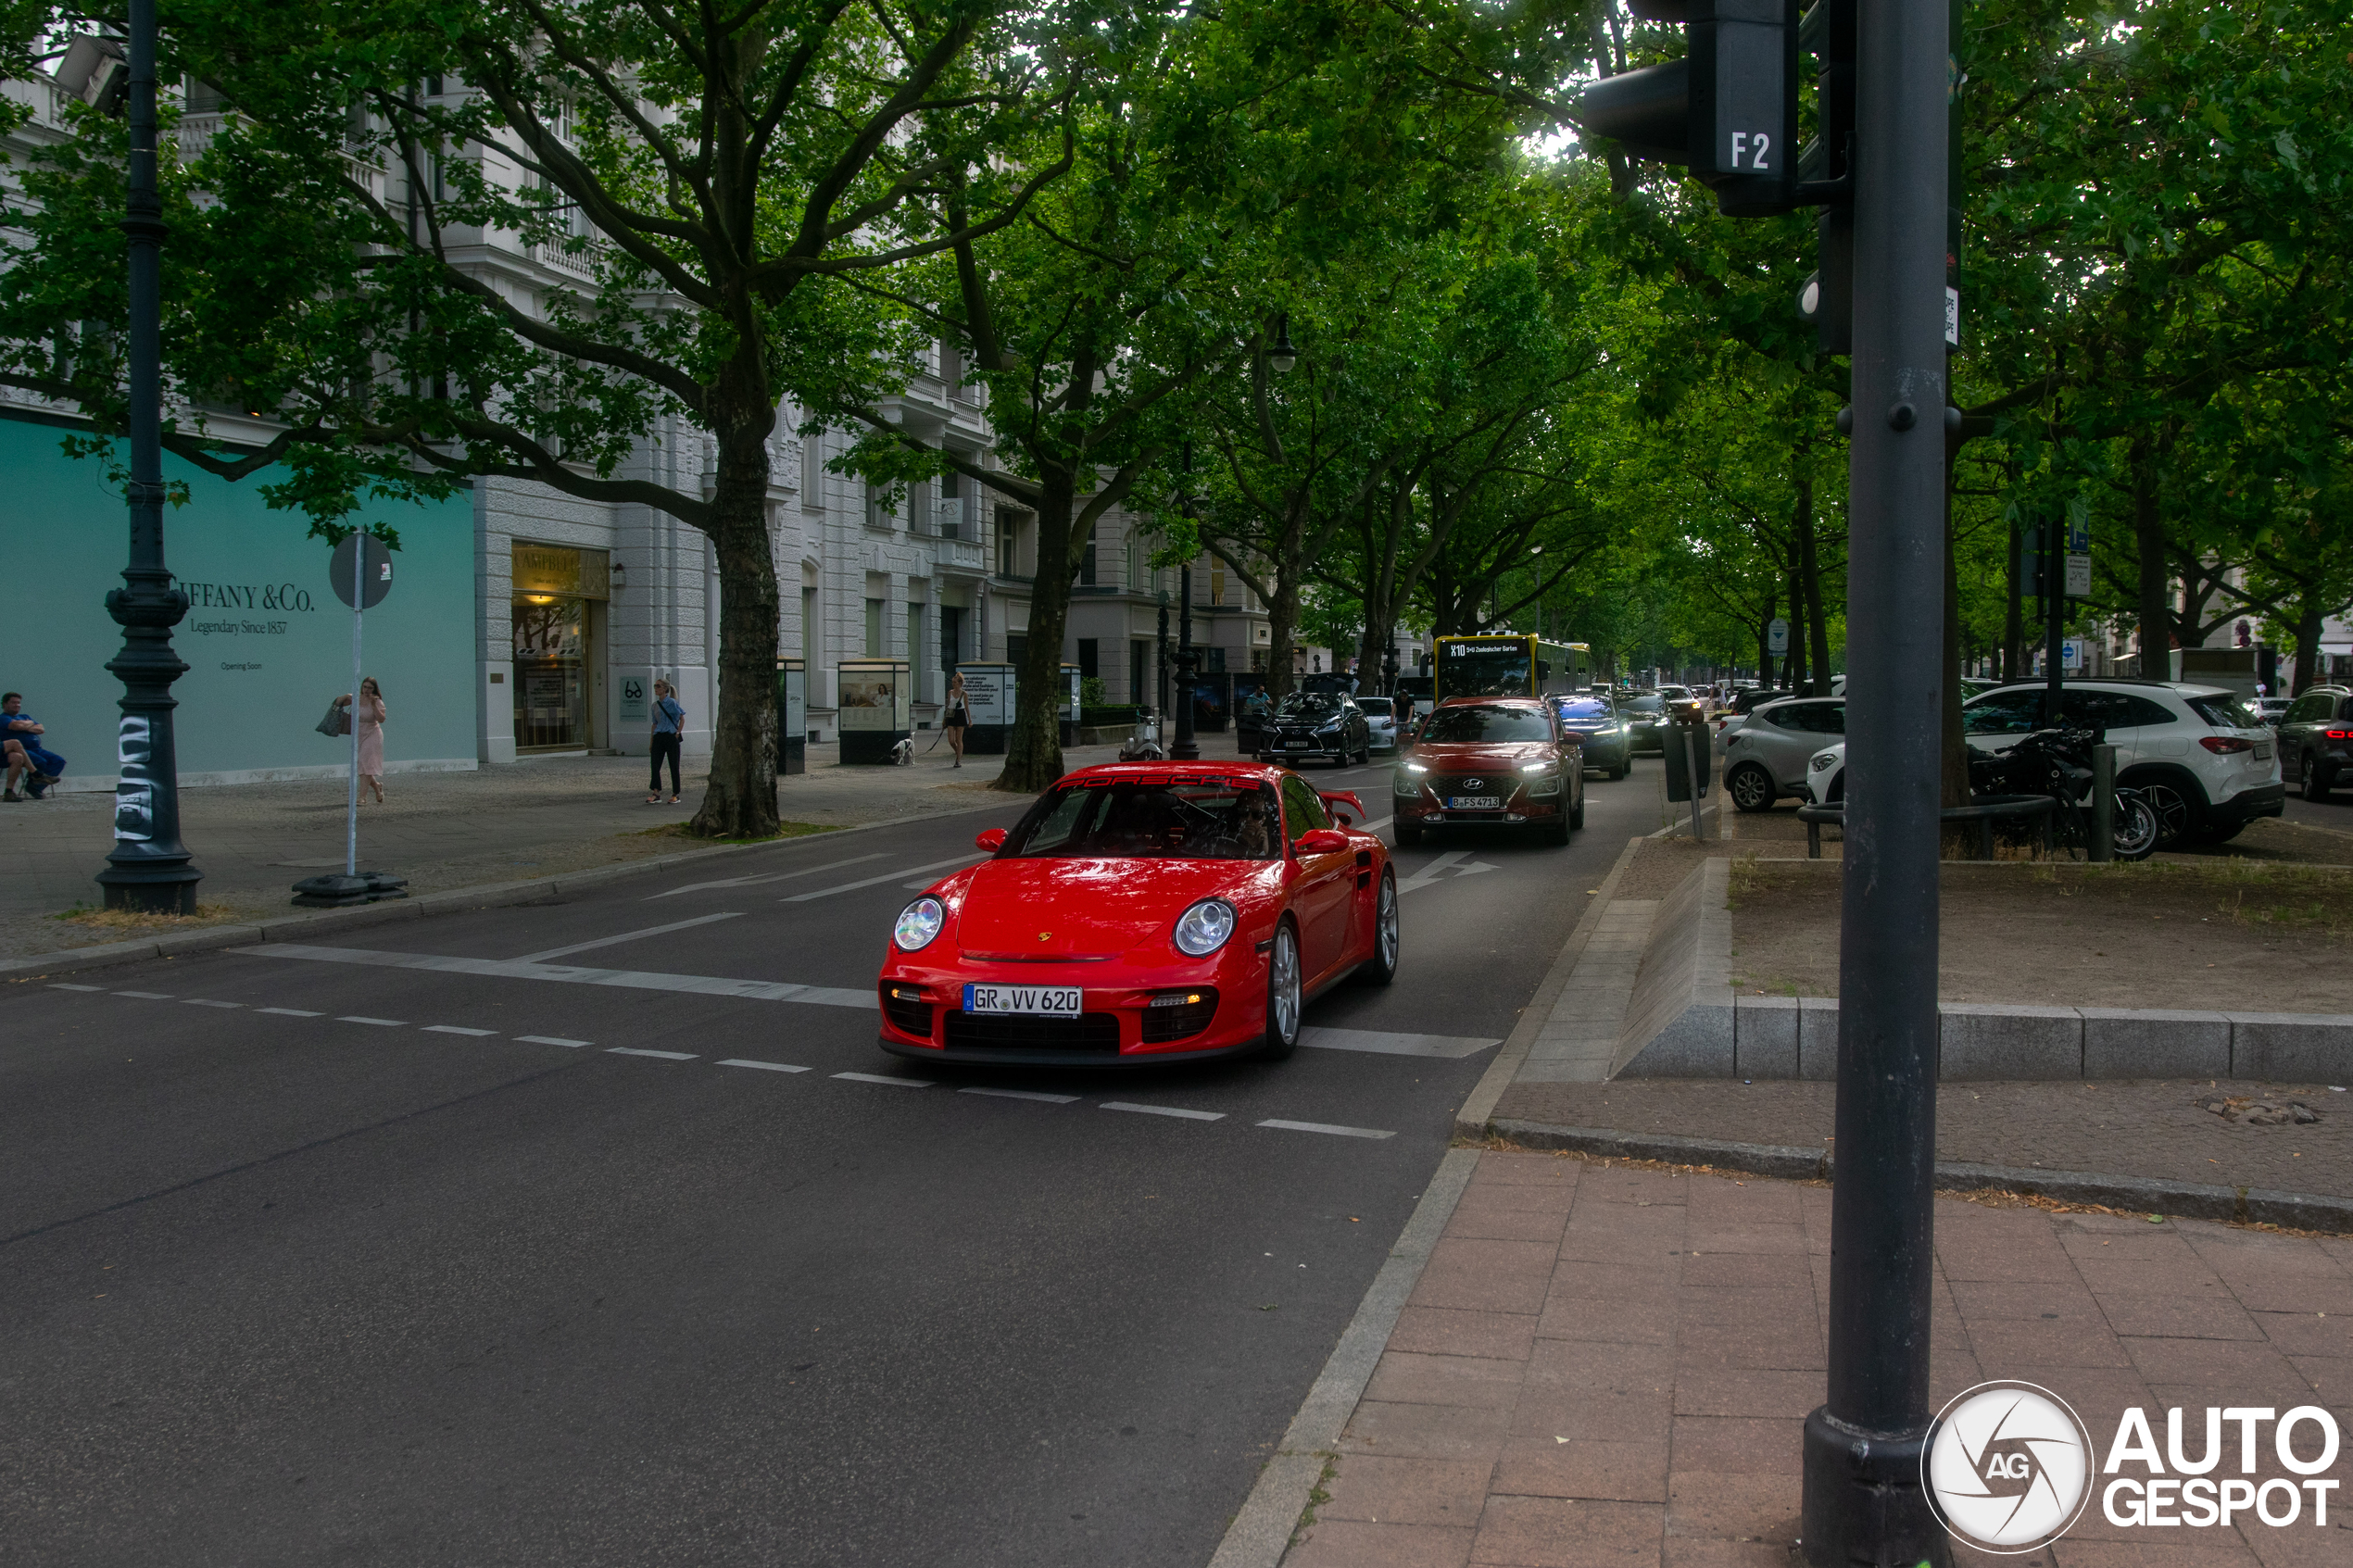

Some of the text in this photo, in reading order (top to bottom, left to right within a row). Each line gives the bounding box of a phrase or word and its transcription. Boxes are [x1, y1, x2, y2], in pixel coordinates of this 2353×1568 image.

[191, 618, 287, 636] Legendary Since 1837
[1451, 645, 1466, 657] X10
[220, 661, 263, 671] Opening Soon
[1055, 775, 1260, 792] PORSCHE
[1453, 797, 1499, 807] B FS 4713
[975, 988, 1079, 1011] GR VV 620
